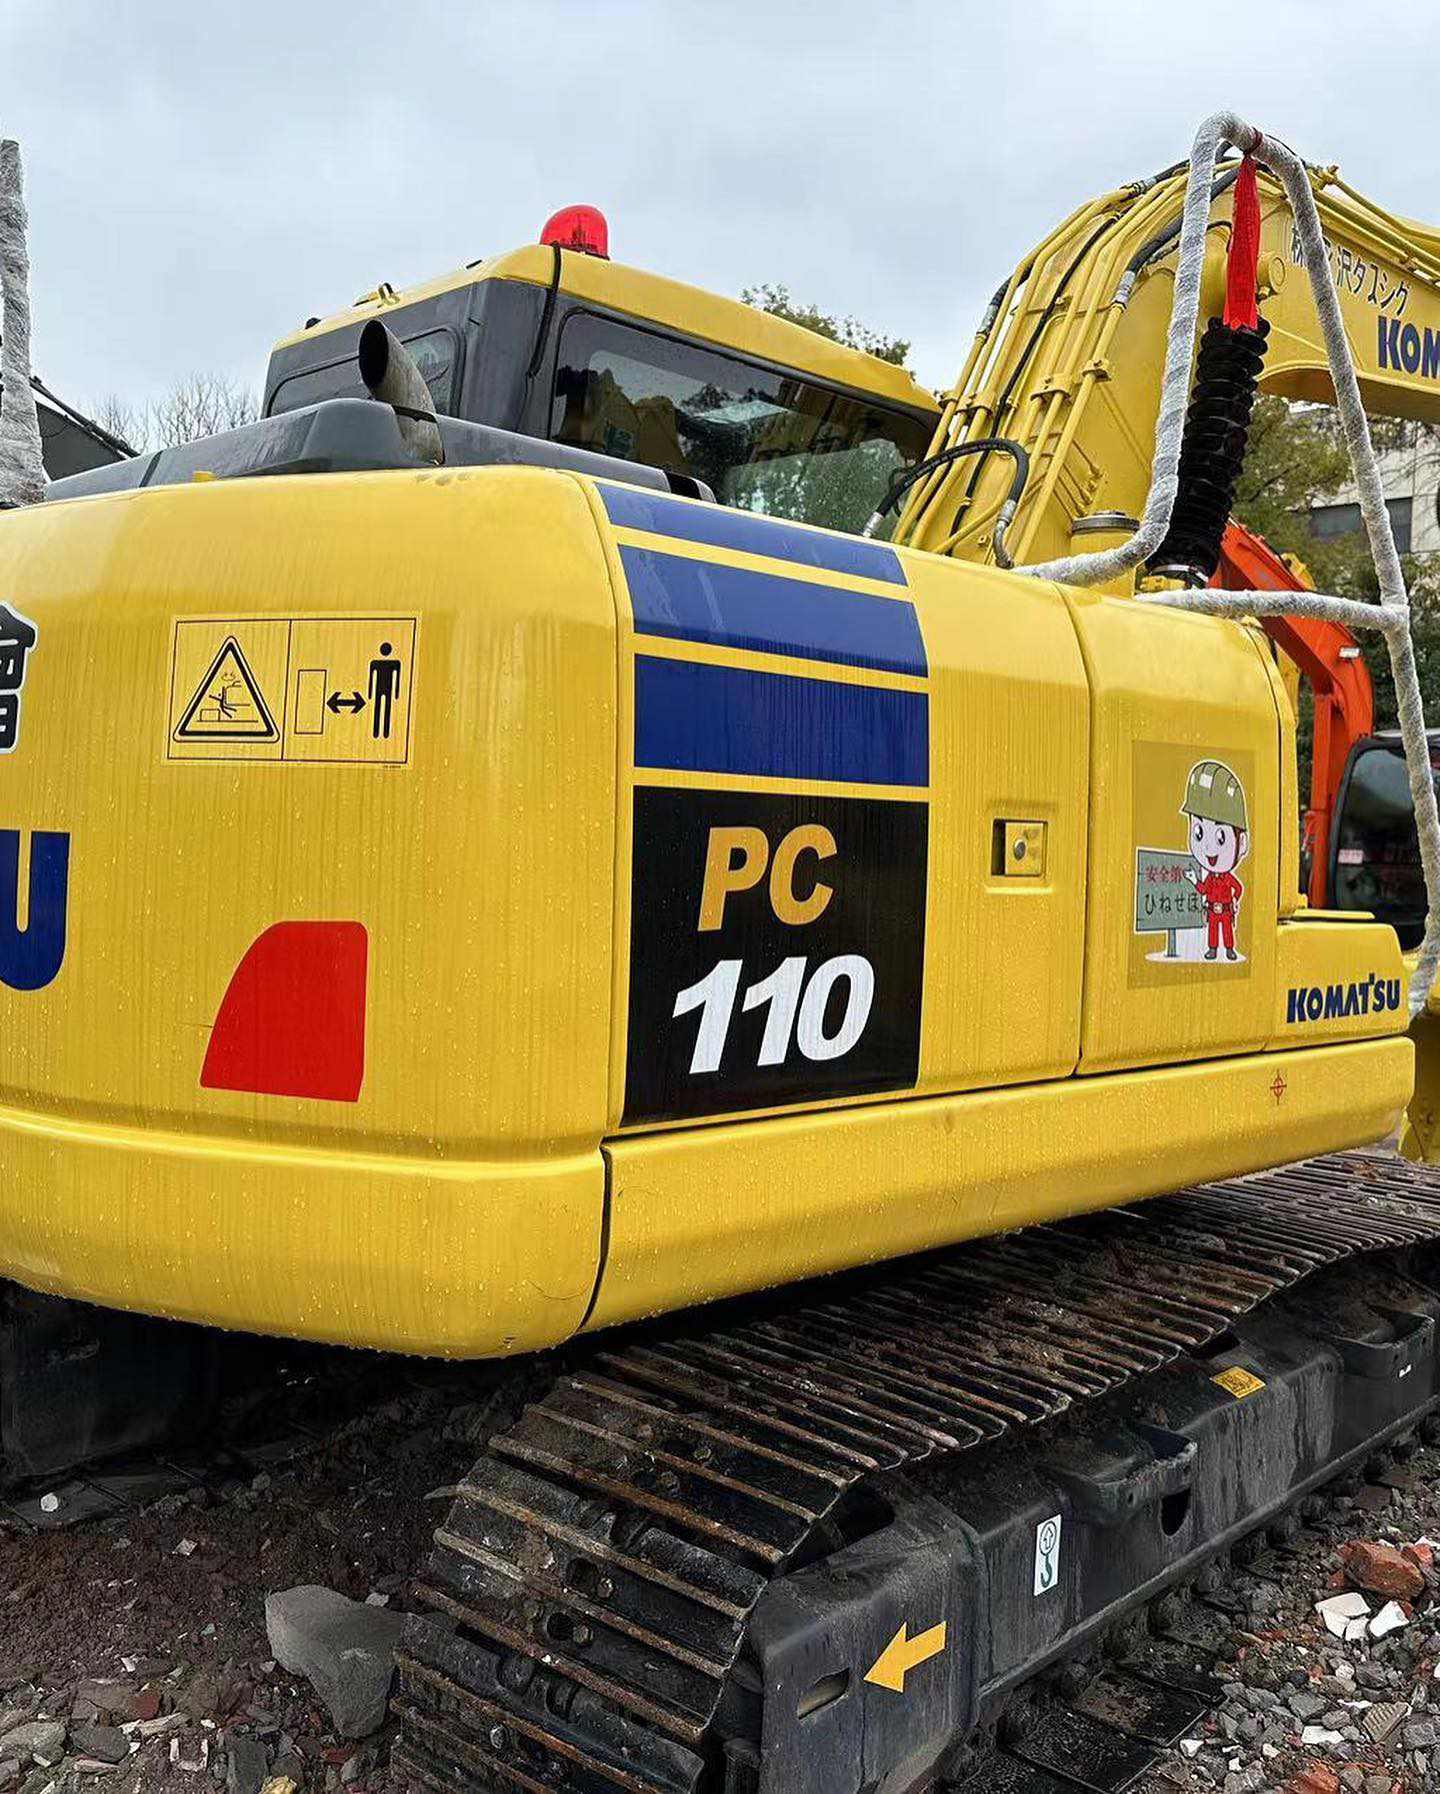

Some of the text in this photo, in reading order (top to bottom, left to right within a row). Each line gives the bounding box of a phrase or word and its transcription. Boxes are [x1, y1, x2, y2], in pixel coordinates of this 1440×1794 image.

[0, 829, 70, 991] U
[697, 823, 838, 932] PC
[672, 954, 875, 1075] 110
[1286, 972, 1400, 1024] KOMATSU
